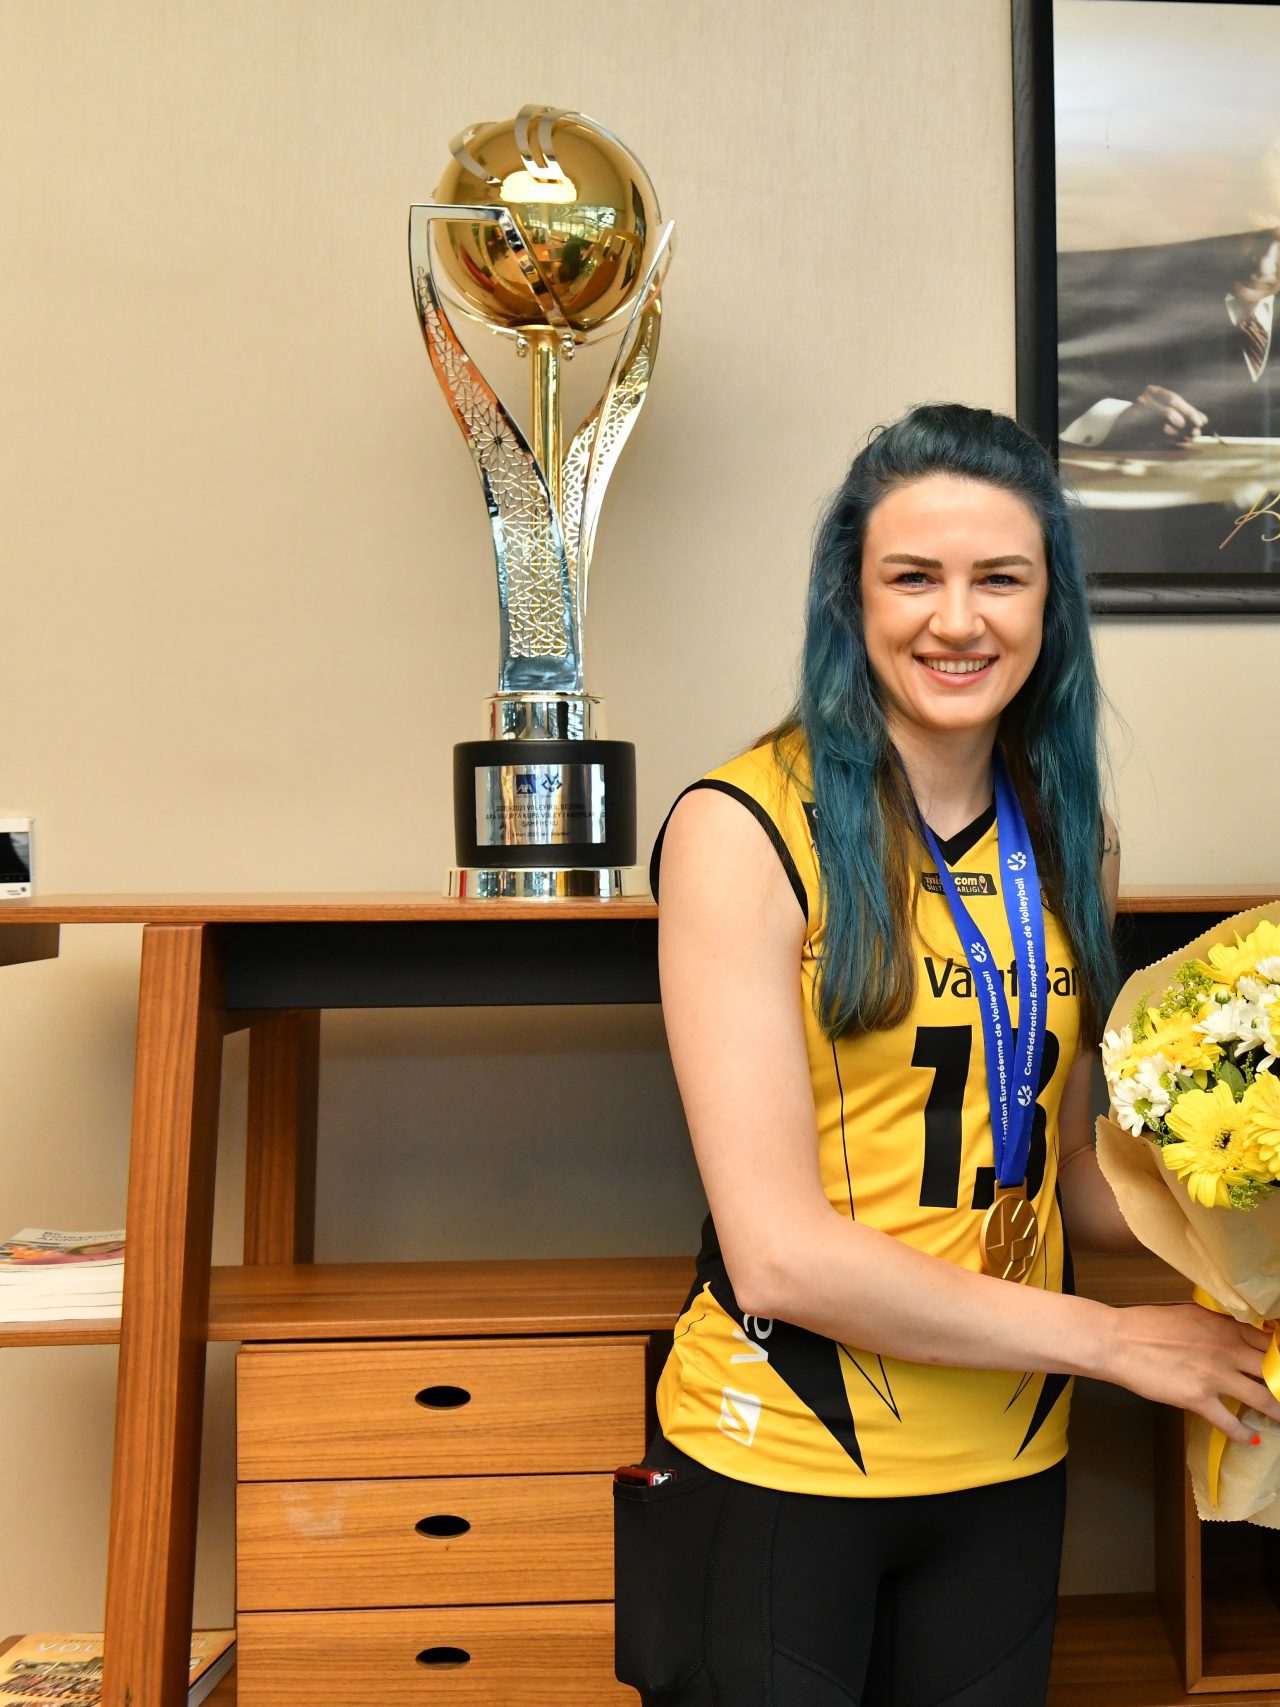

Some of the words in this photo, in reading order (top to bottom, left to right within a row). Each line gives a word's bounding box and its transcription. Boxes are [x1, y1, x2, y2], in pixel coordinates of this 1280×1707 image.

[517, 784, 533, 793] AXA
[1015, 877, 1030, 924] Volleyball
[1023, 925, 1032, 938] de
[1026, 940, 1038, 998] Européenne
[982, 970, 1000, 1022] Volleyball
[995, 1023, 1003, 1037] de
[1024, 1000, 1038, 1076] Confédération
[997, 1039, 1007, 1102] Européenne
